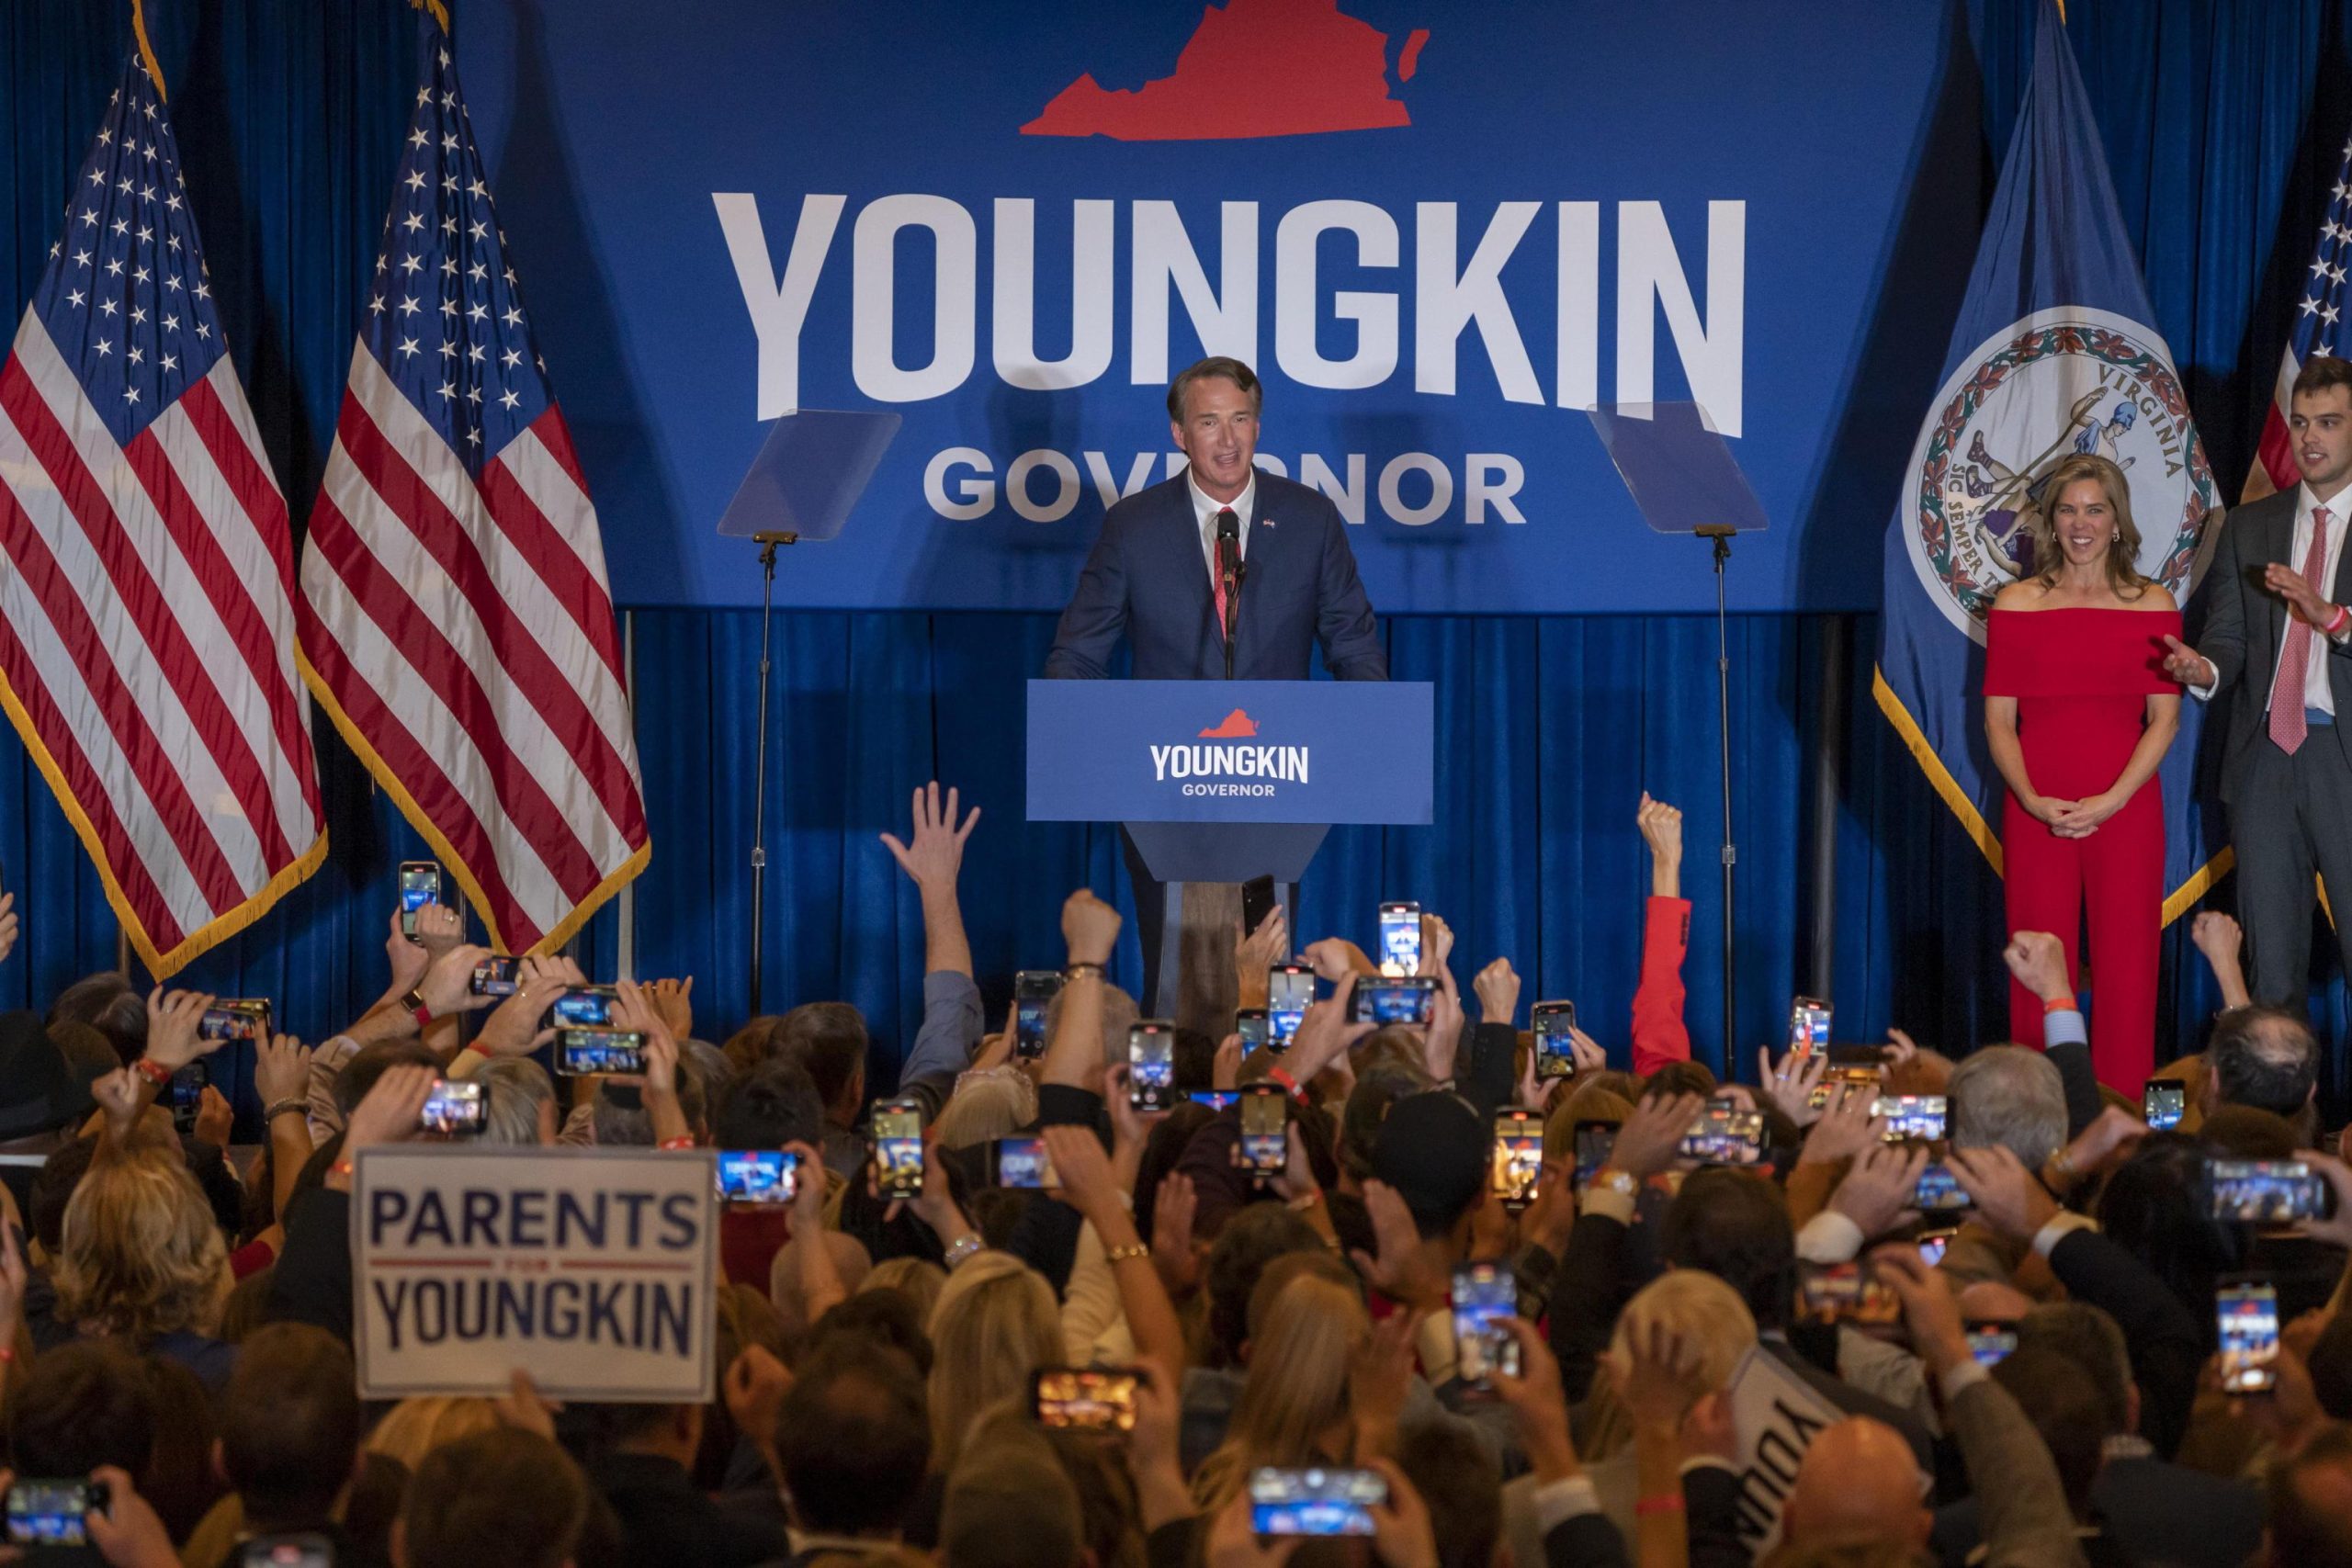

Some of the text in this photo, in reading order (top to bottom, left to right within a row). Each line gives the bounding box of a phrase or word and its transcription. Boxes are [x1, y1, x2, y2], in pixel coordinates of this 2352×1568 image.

[712, 192, 1746, 438] YOUNGKIN
[2098, 363, 2185, 478] VIRGINIA
[922, 446, 1528, 525] GOVNOR
[1947, 463, 1984, 576] SIC SEMPER
[1150, 745, 1308, 784] YOUNGKIN
[1182, 784, 1275, 796] GOVERNOR
[369, 1188, 698, 1250] PARENTS
[372, 1277, 693, 1359] YOUNGKIN
